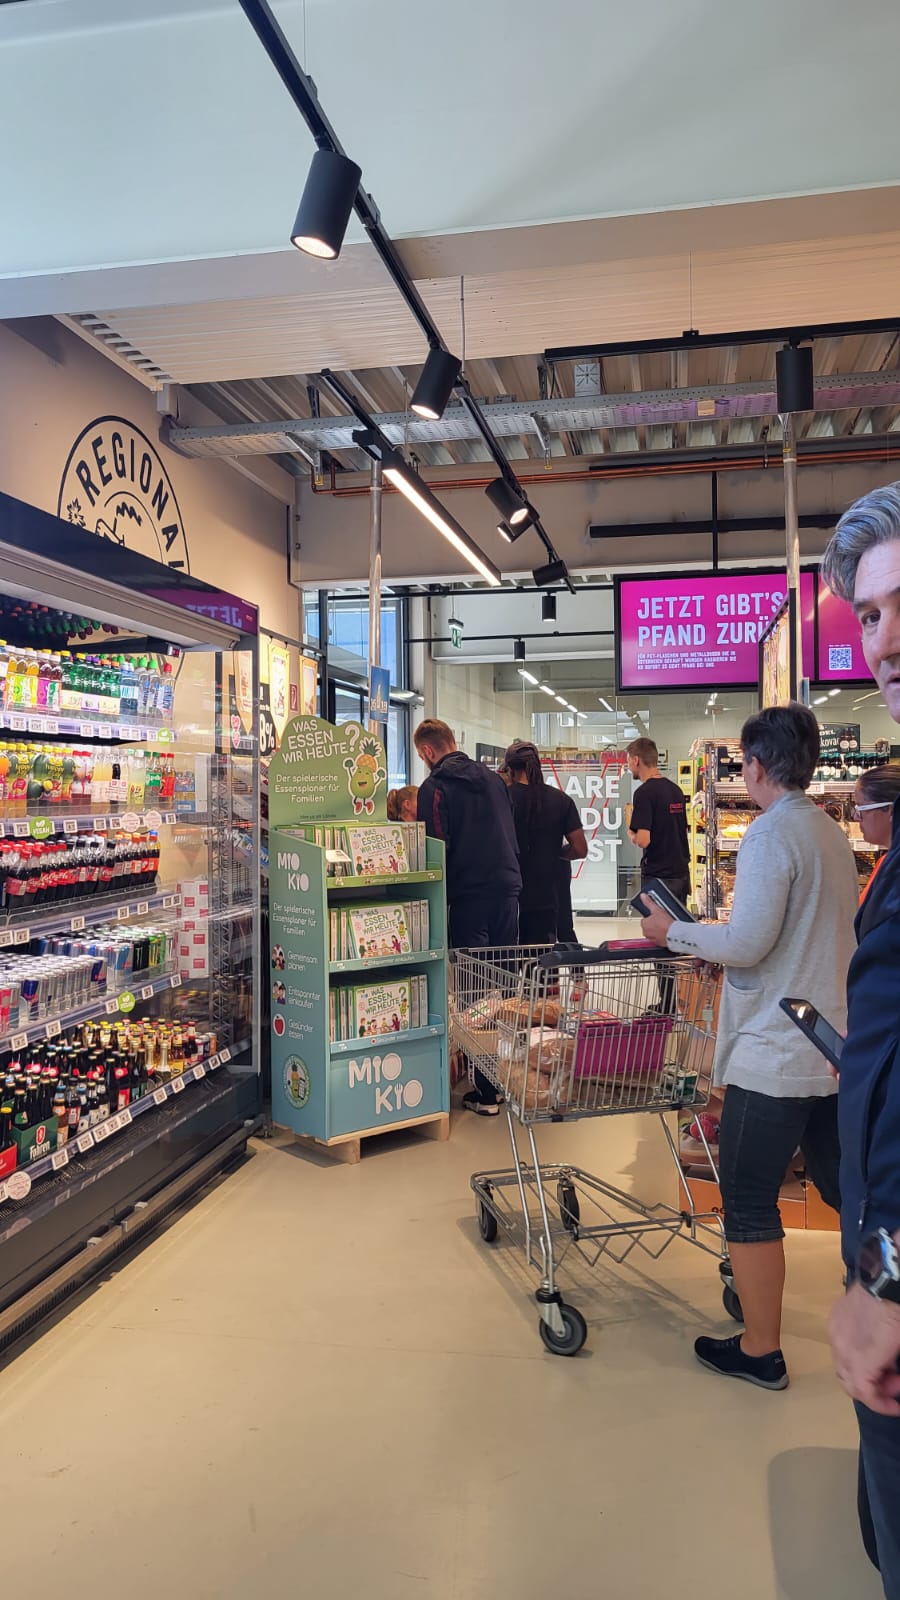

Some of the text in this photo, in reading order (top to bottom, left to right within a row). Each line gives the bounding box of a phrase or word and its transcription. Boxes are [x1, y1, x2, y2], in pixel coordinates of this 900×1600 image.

[637, 591, 784, 619] JETZT GIBT'S
[638, 616, 769, 647] PFAND ZURÜ
[293, 719, 318, 733] WAS
[288, 729, 334, 750] ESSEN
[282, 750, 304, 763] WIR
[276, 774, 339, 783] Der spielerische
[275, 784, 341, 794] Essensplaner für
[291, 794, 325, 803] Familien
[580, 807, 623, 831] DU
[277, 852, 300, 871] MIO
[288, 873, 309, 892] KIO
[367, 992, 393, 1006] ESSEN
[371, 986, 385, 996] WAS
[349, 1053, 402, 1089] MIO
[375, 1079, 423, 1115] KIO
